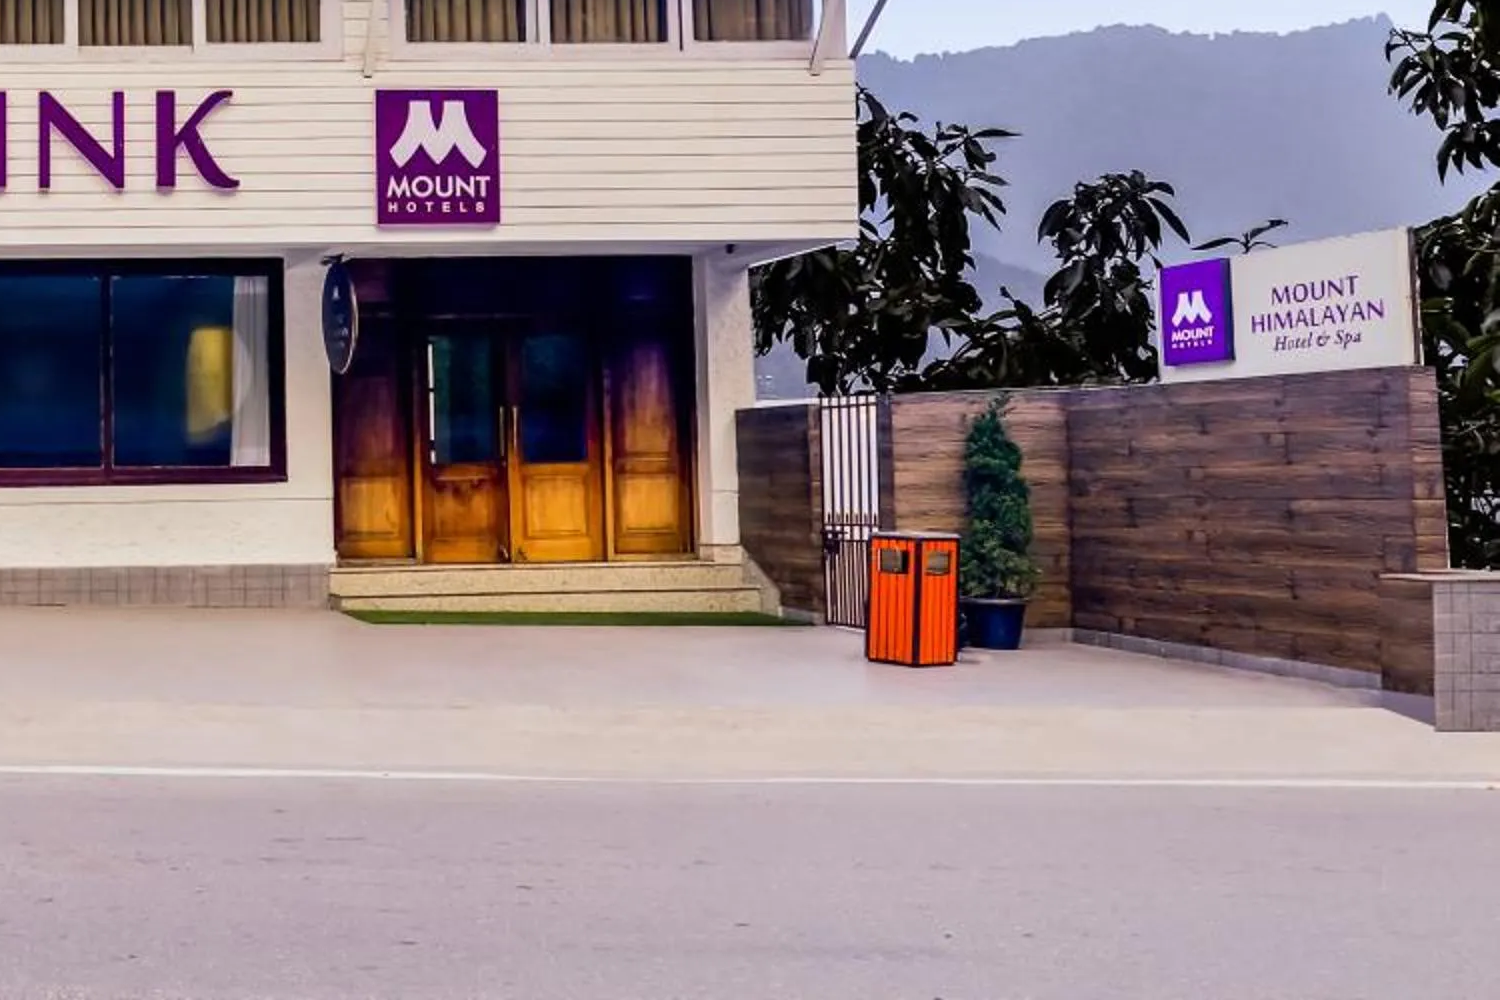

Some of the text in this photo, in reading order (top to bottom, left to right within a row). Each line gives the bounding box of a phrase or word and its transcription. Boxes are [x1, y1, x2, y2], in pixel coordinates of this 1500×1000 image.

[387, 175, 491, 198] MOUNT
[387, 201, 485, 213] HOTELS
[1271, 275, 1358, 306] MOUNT
[1251, 299, 1385, 334] HIMALAYAN
[1171, 326, 1215, 342] MOUNT
[1274, 329, 1363, 352] Hotel & Spa
